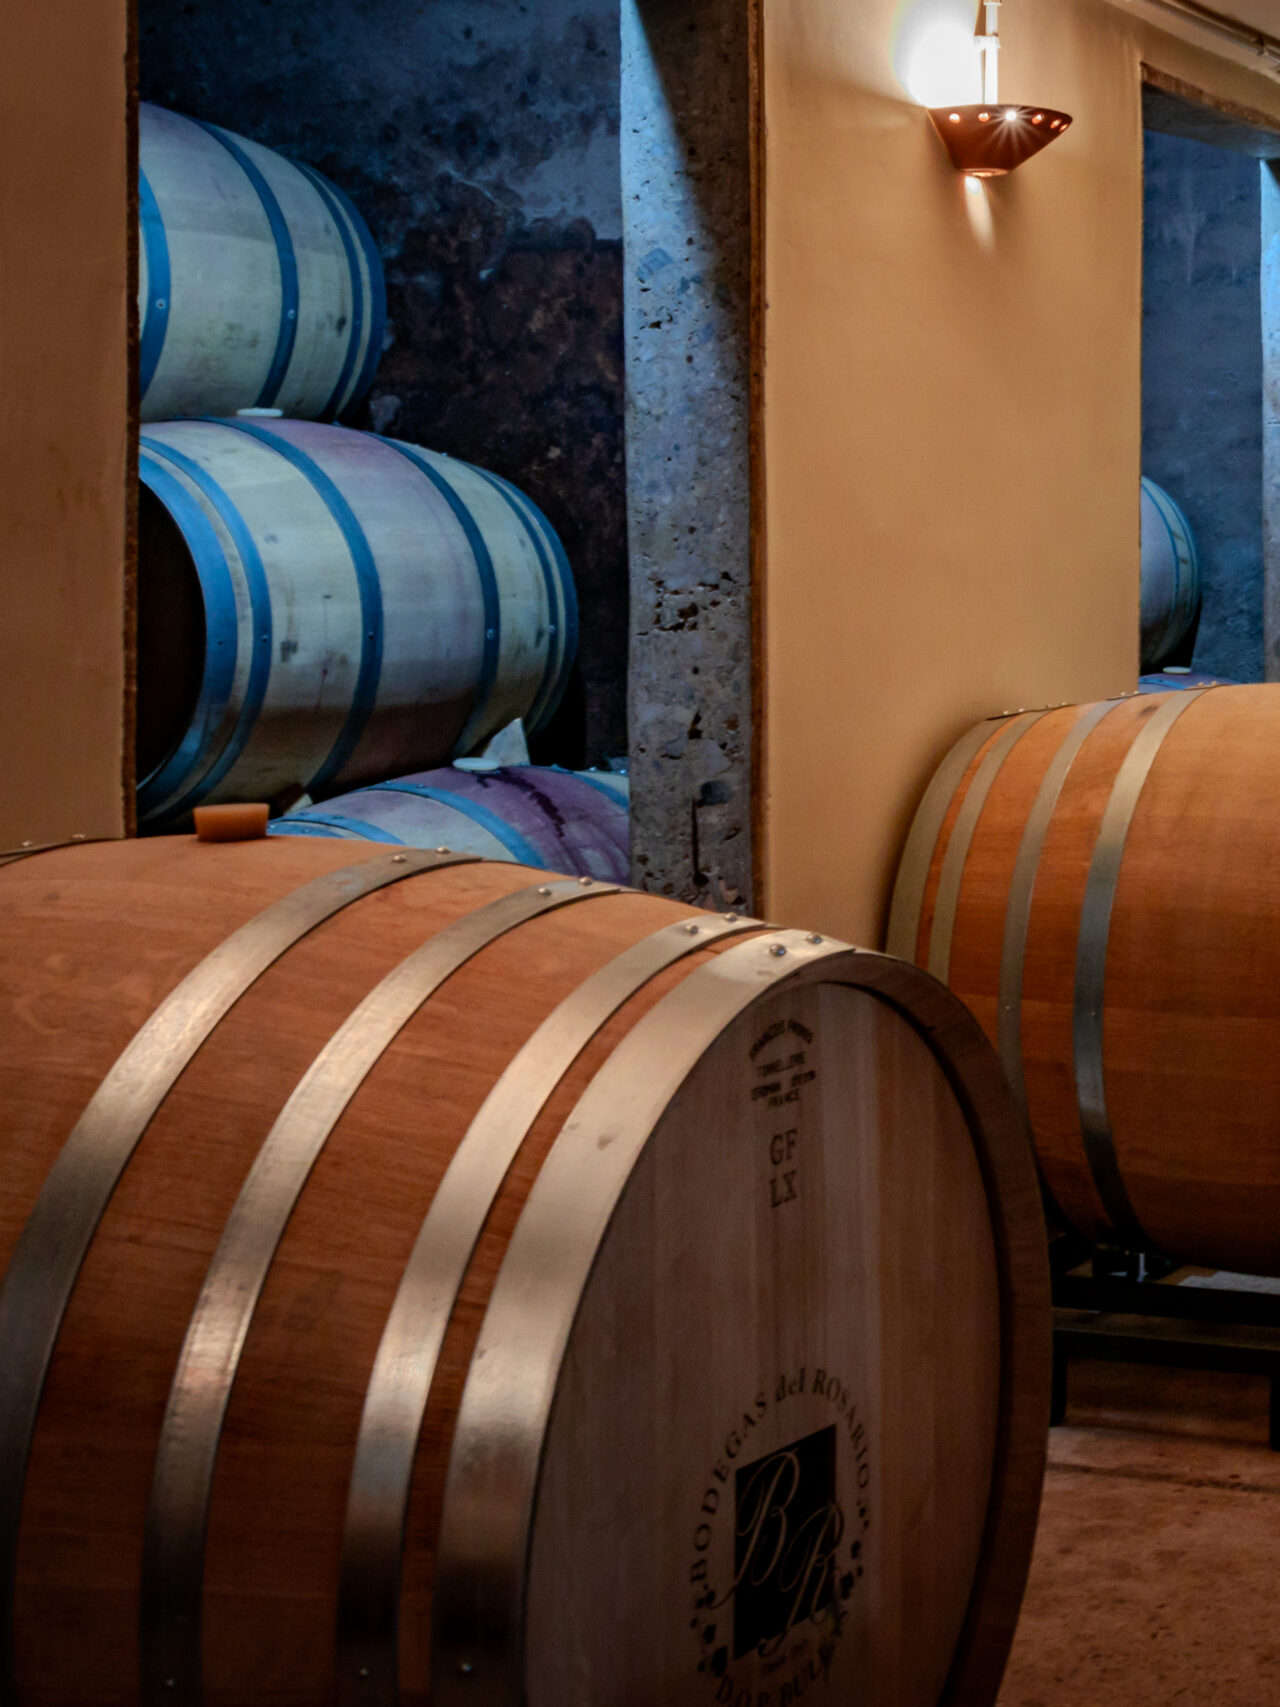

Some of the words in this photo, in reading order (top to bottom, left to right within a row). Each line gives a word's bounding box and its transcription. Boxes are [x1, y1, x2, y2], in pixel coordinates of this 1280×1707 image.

[769, 1129, 797, 1166] GF
[769, 1170, 798, 1208] LX
[690, 1391, 768, 1584] BODEGAS
[775, 1368, 806, 1402] del
[812, 1368, 871, 1489] ROSARIO
